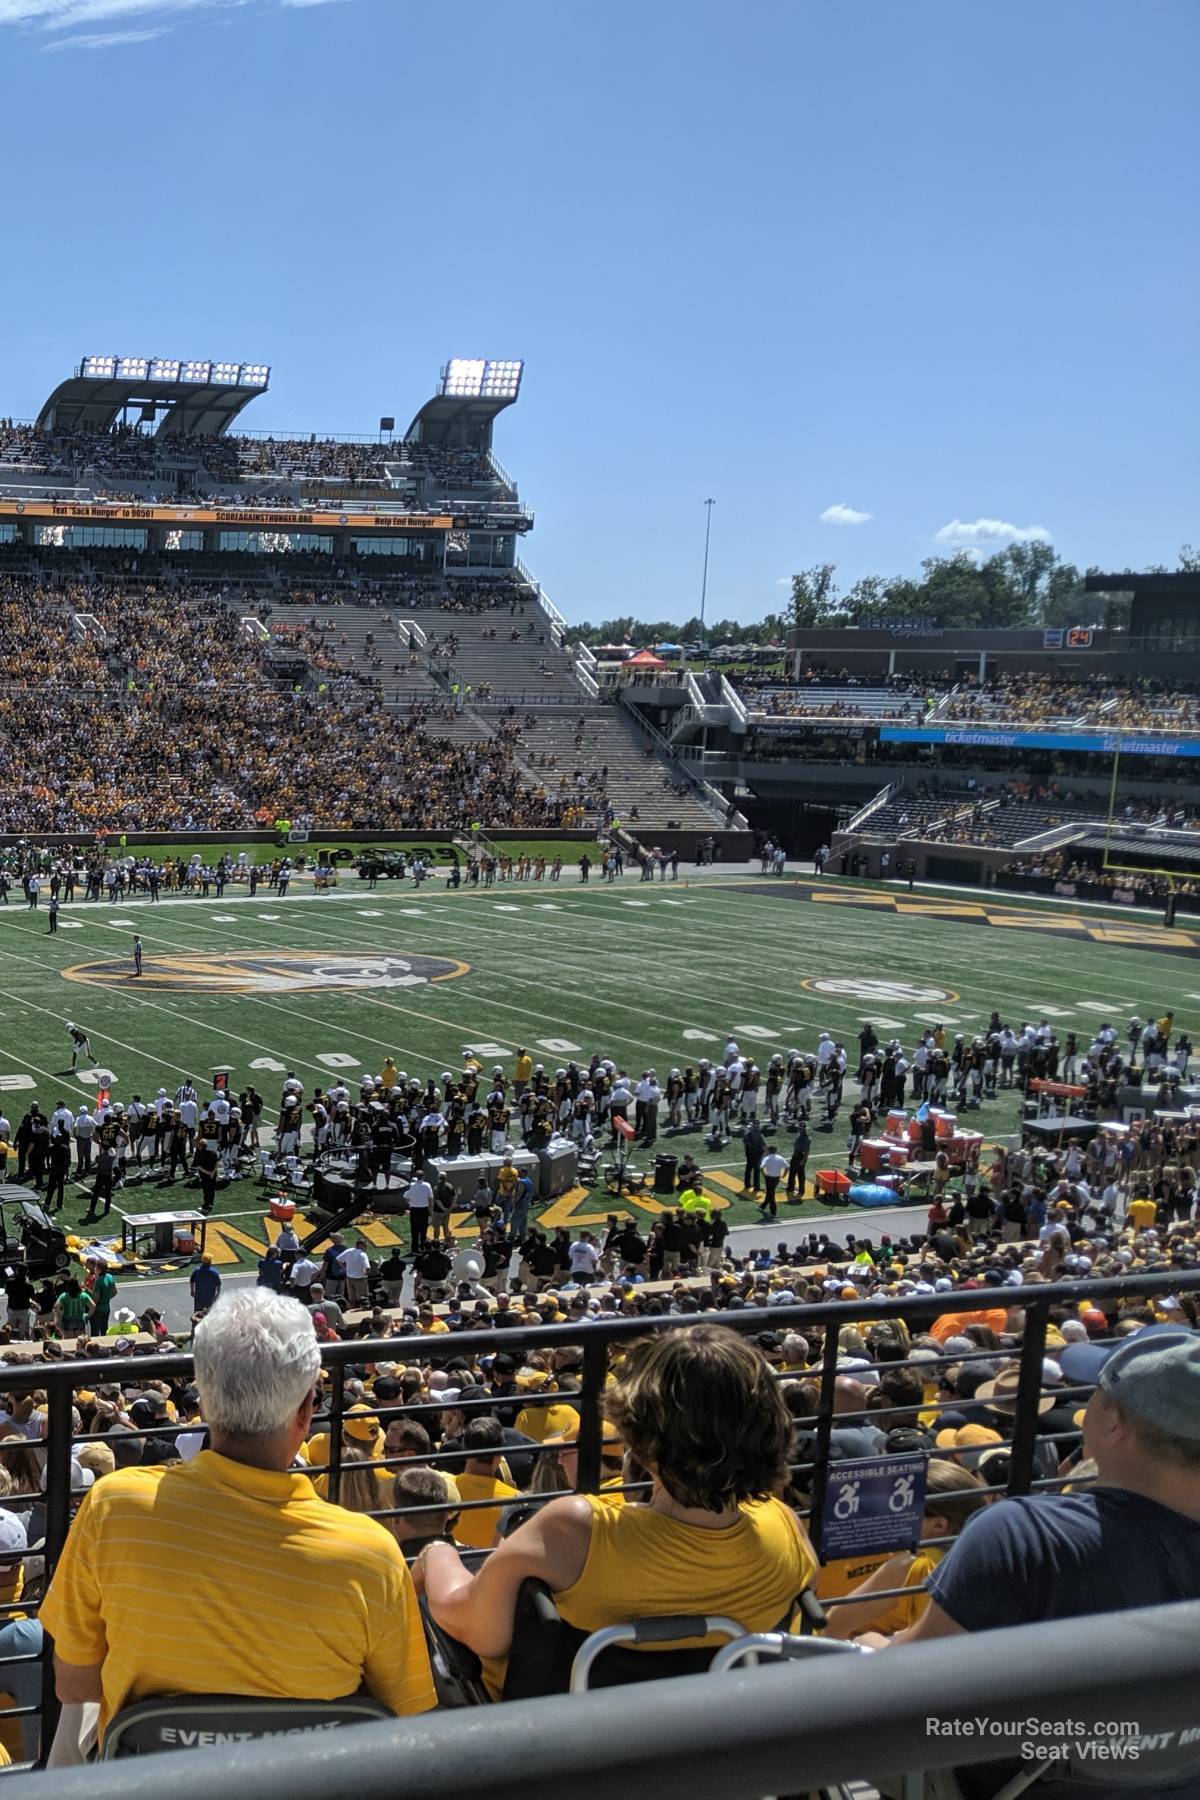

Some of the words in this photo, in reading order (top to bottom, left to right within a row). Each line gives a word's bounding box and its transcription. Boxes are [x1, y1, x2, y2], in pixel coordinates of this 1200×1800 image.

[52, 506, 68, 515] Text
[69, 506, 90, 516] "Sack
[122, 508, 130, 517] to
[131, 508, 154, 518] 90561
[215, 512, 314, 524] SCOREAGAINSTHUNGER.ORG
[374, 515, 392, 527] Help
[393, 516, 406, 527] End
[407, 516, 435, 528] Hunger
[1070, 631, 1089, 645] 24
[813, 727, 849, 736] Learfield
[944, 731, 1017, 746] ticketmaster
[829, 1467, 885, 1482] ACCESSIBLE
[886, 1462, 925, 1475] SEATING
[160, 1727, 253, 1747] EVENT
